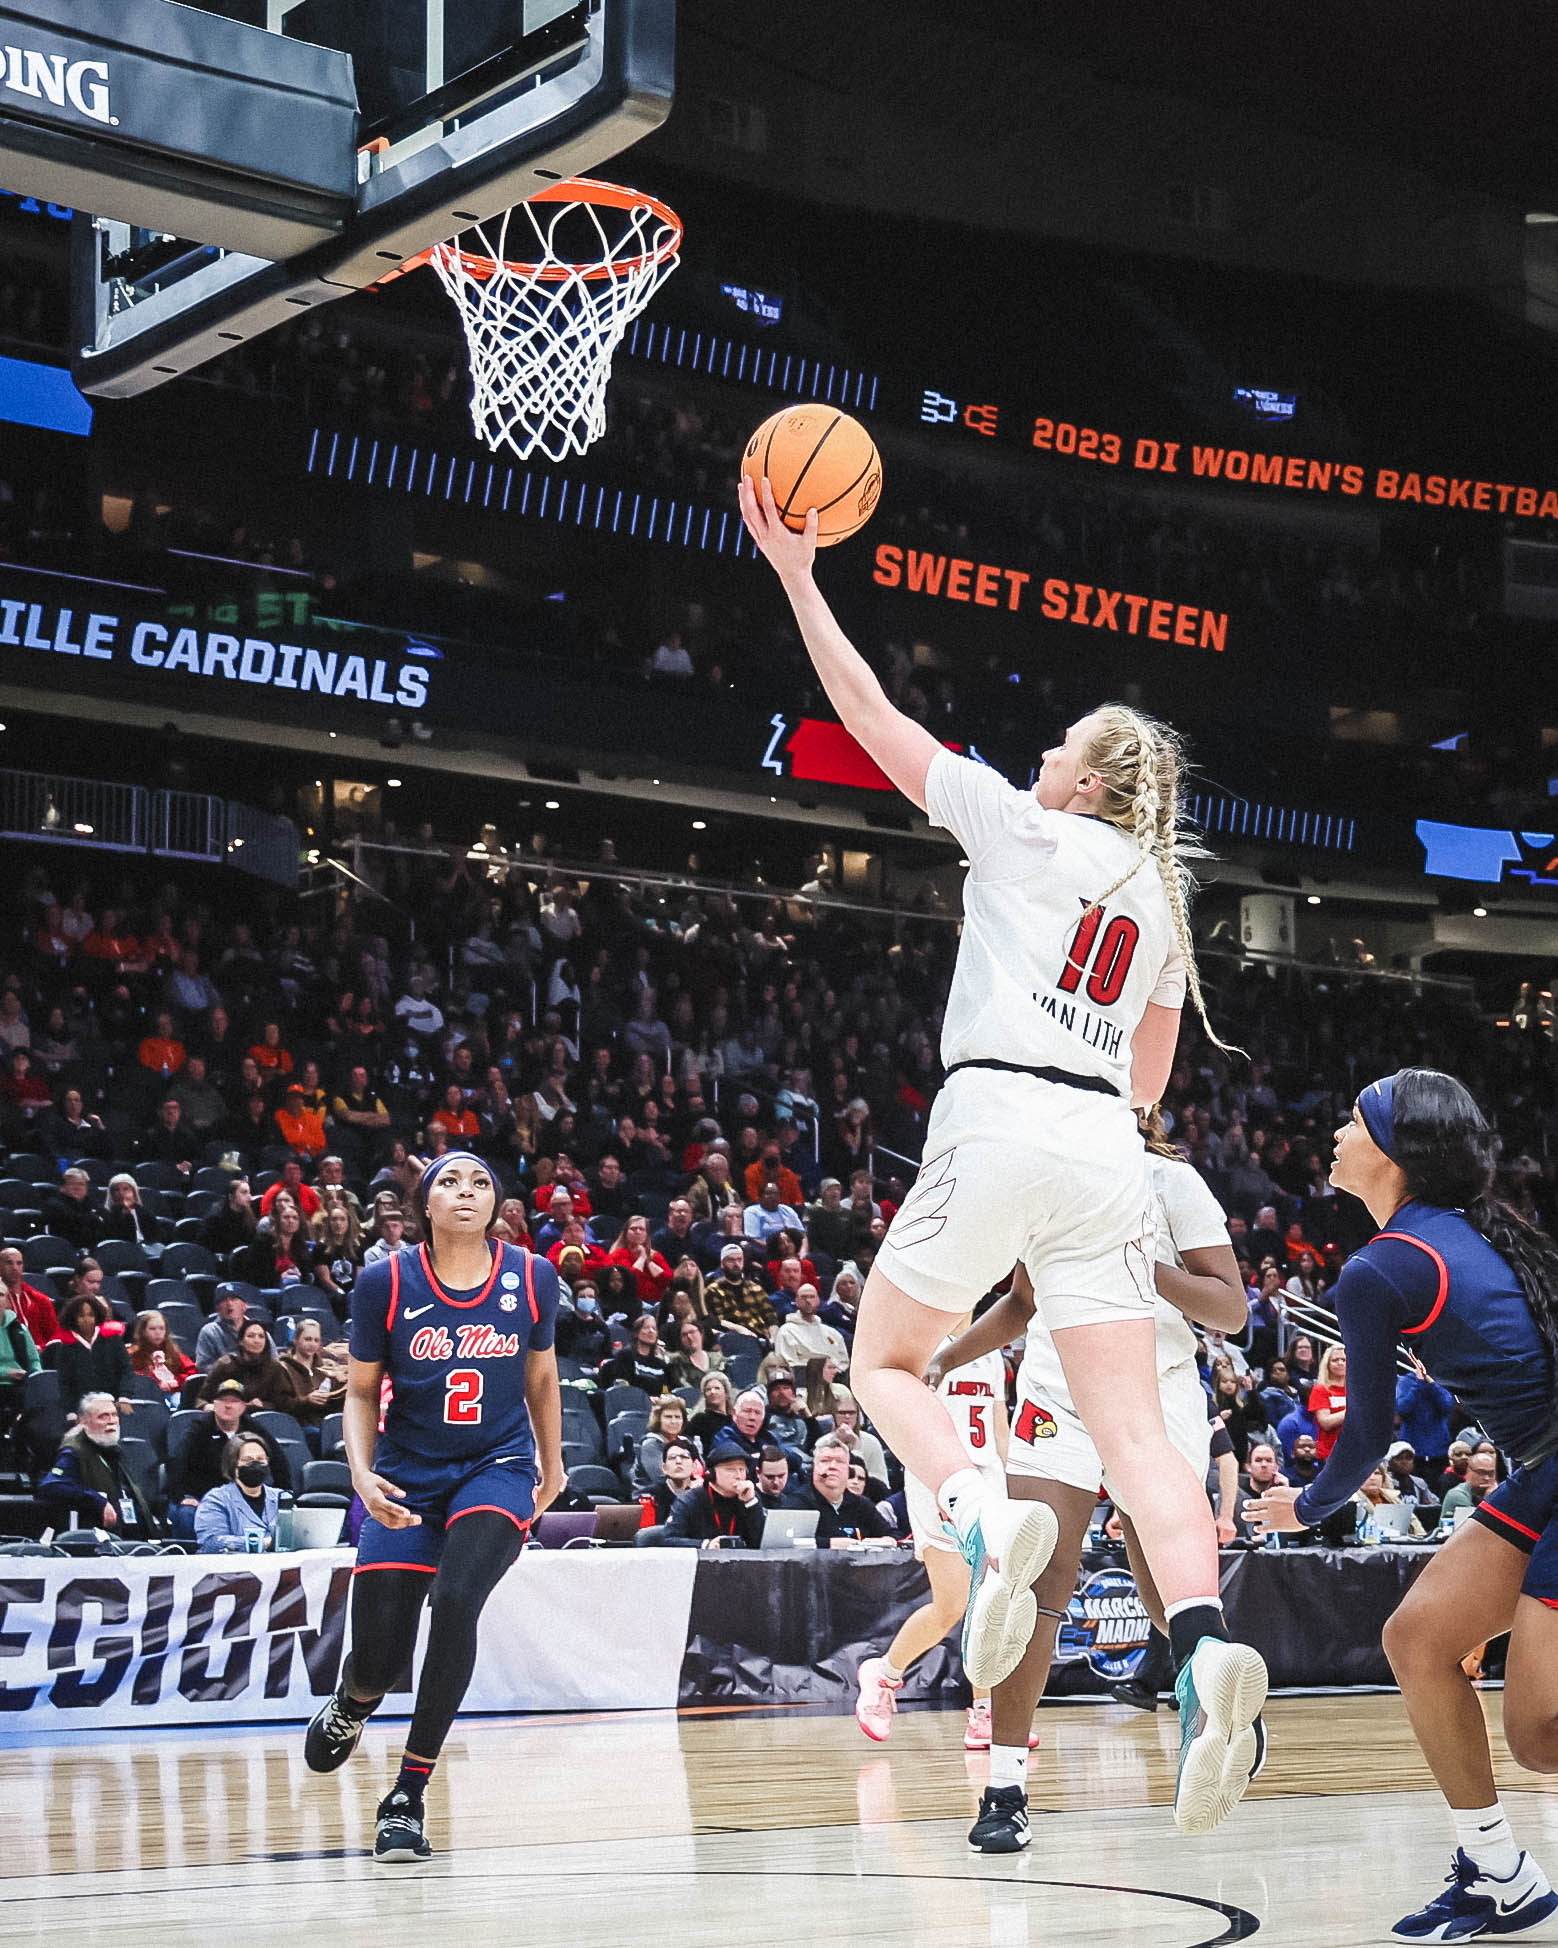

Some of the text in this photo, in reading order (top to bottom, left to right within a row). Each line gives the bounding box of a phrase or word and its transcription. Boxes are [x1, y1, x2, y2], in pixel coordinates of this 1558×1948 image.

[0, 46, 110, 124] ING
[1033, 417, 1558, 518] 2023 DI WOMEN'S BASKETBA
[872, 544, 1229, 652] SWEET SIXTEEN
[0, 598, 431, 708] ILLE CARDINALS
[1056, 896, 1140, 1007] 10
[1082, 1012, 1124, 1059] LITH
[409, 1324, 519, 1361] Ole Miss
[443, 1368, 484, 1425] 2
[969, 1404, 987, 1449] 5
[1083, 1596, 1150, 1619] MARCH
